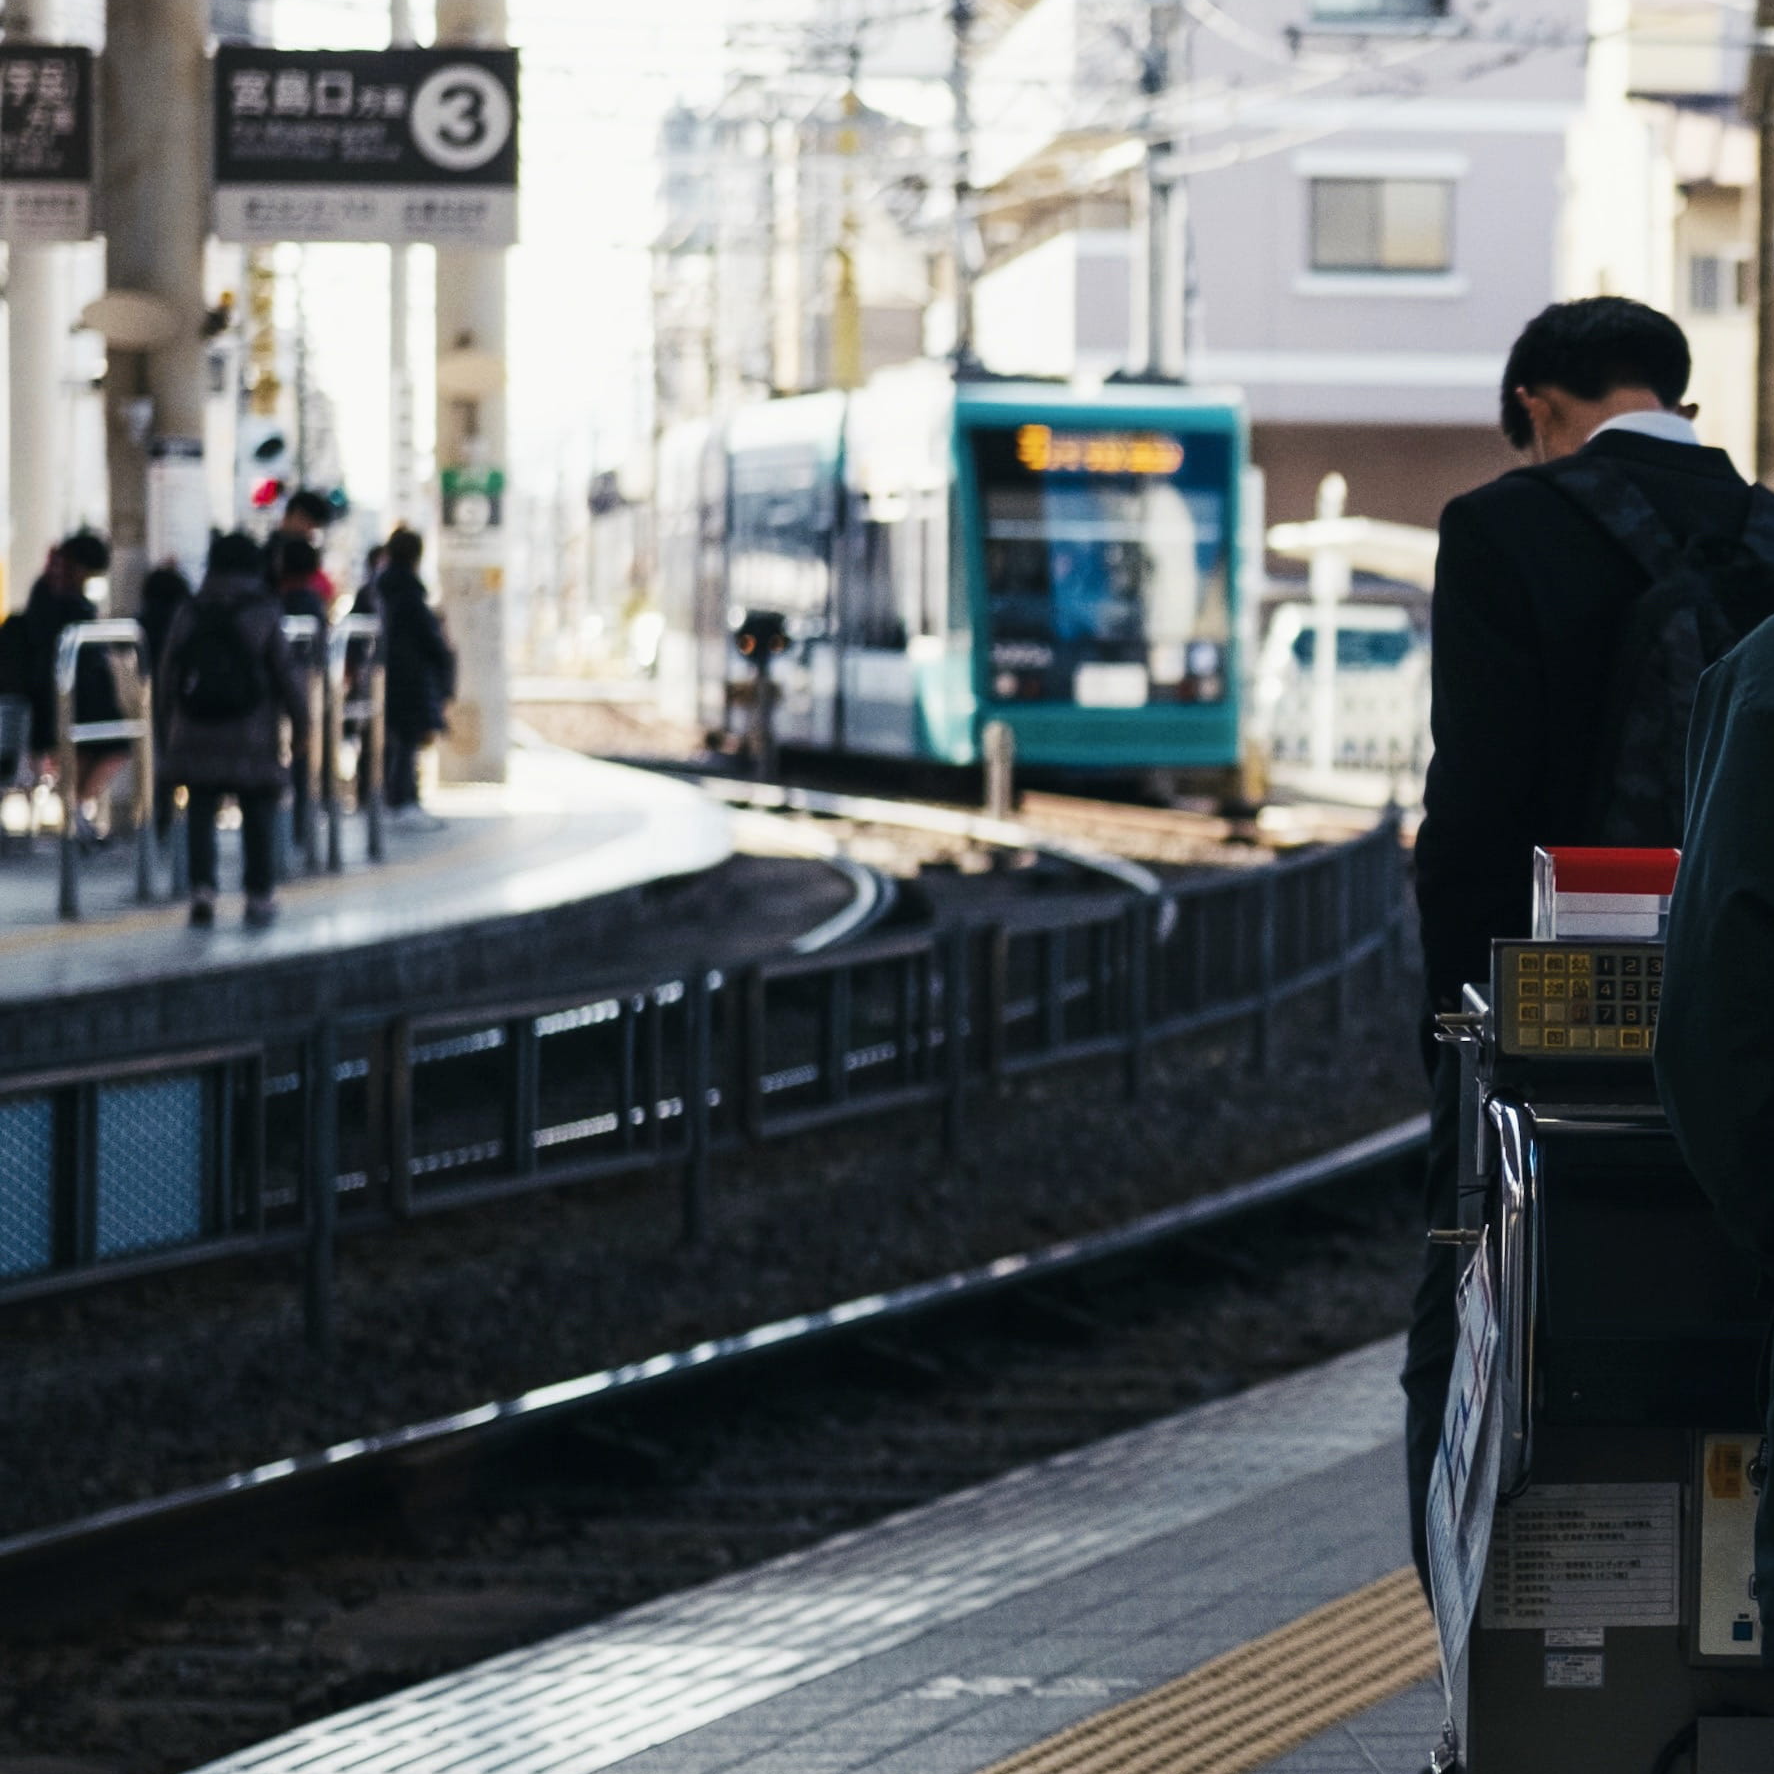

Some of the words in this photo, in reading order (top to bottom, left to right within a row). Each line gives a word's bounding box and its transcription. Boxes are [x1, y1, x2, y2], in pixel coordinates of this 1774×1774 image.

[436, 83, 488, 149] 3
[1624, 959, 1638, 971] 2
[1651, 960, 1663, 972] 3
[1600, 984, 1611, 996] 4
[1625, 985, 1637, 996] 5
[1651, 985, 1661, 996] 6
[1601, 1008, 1611, 1020] 7
[1625, 1008, 1637, 1020] 8
